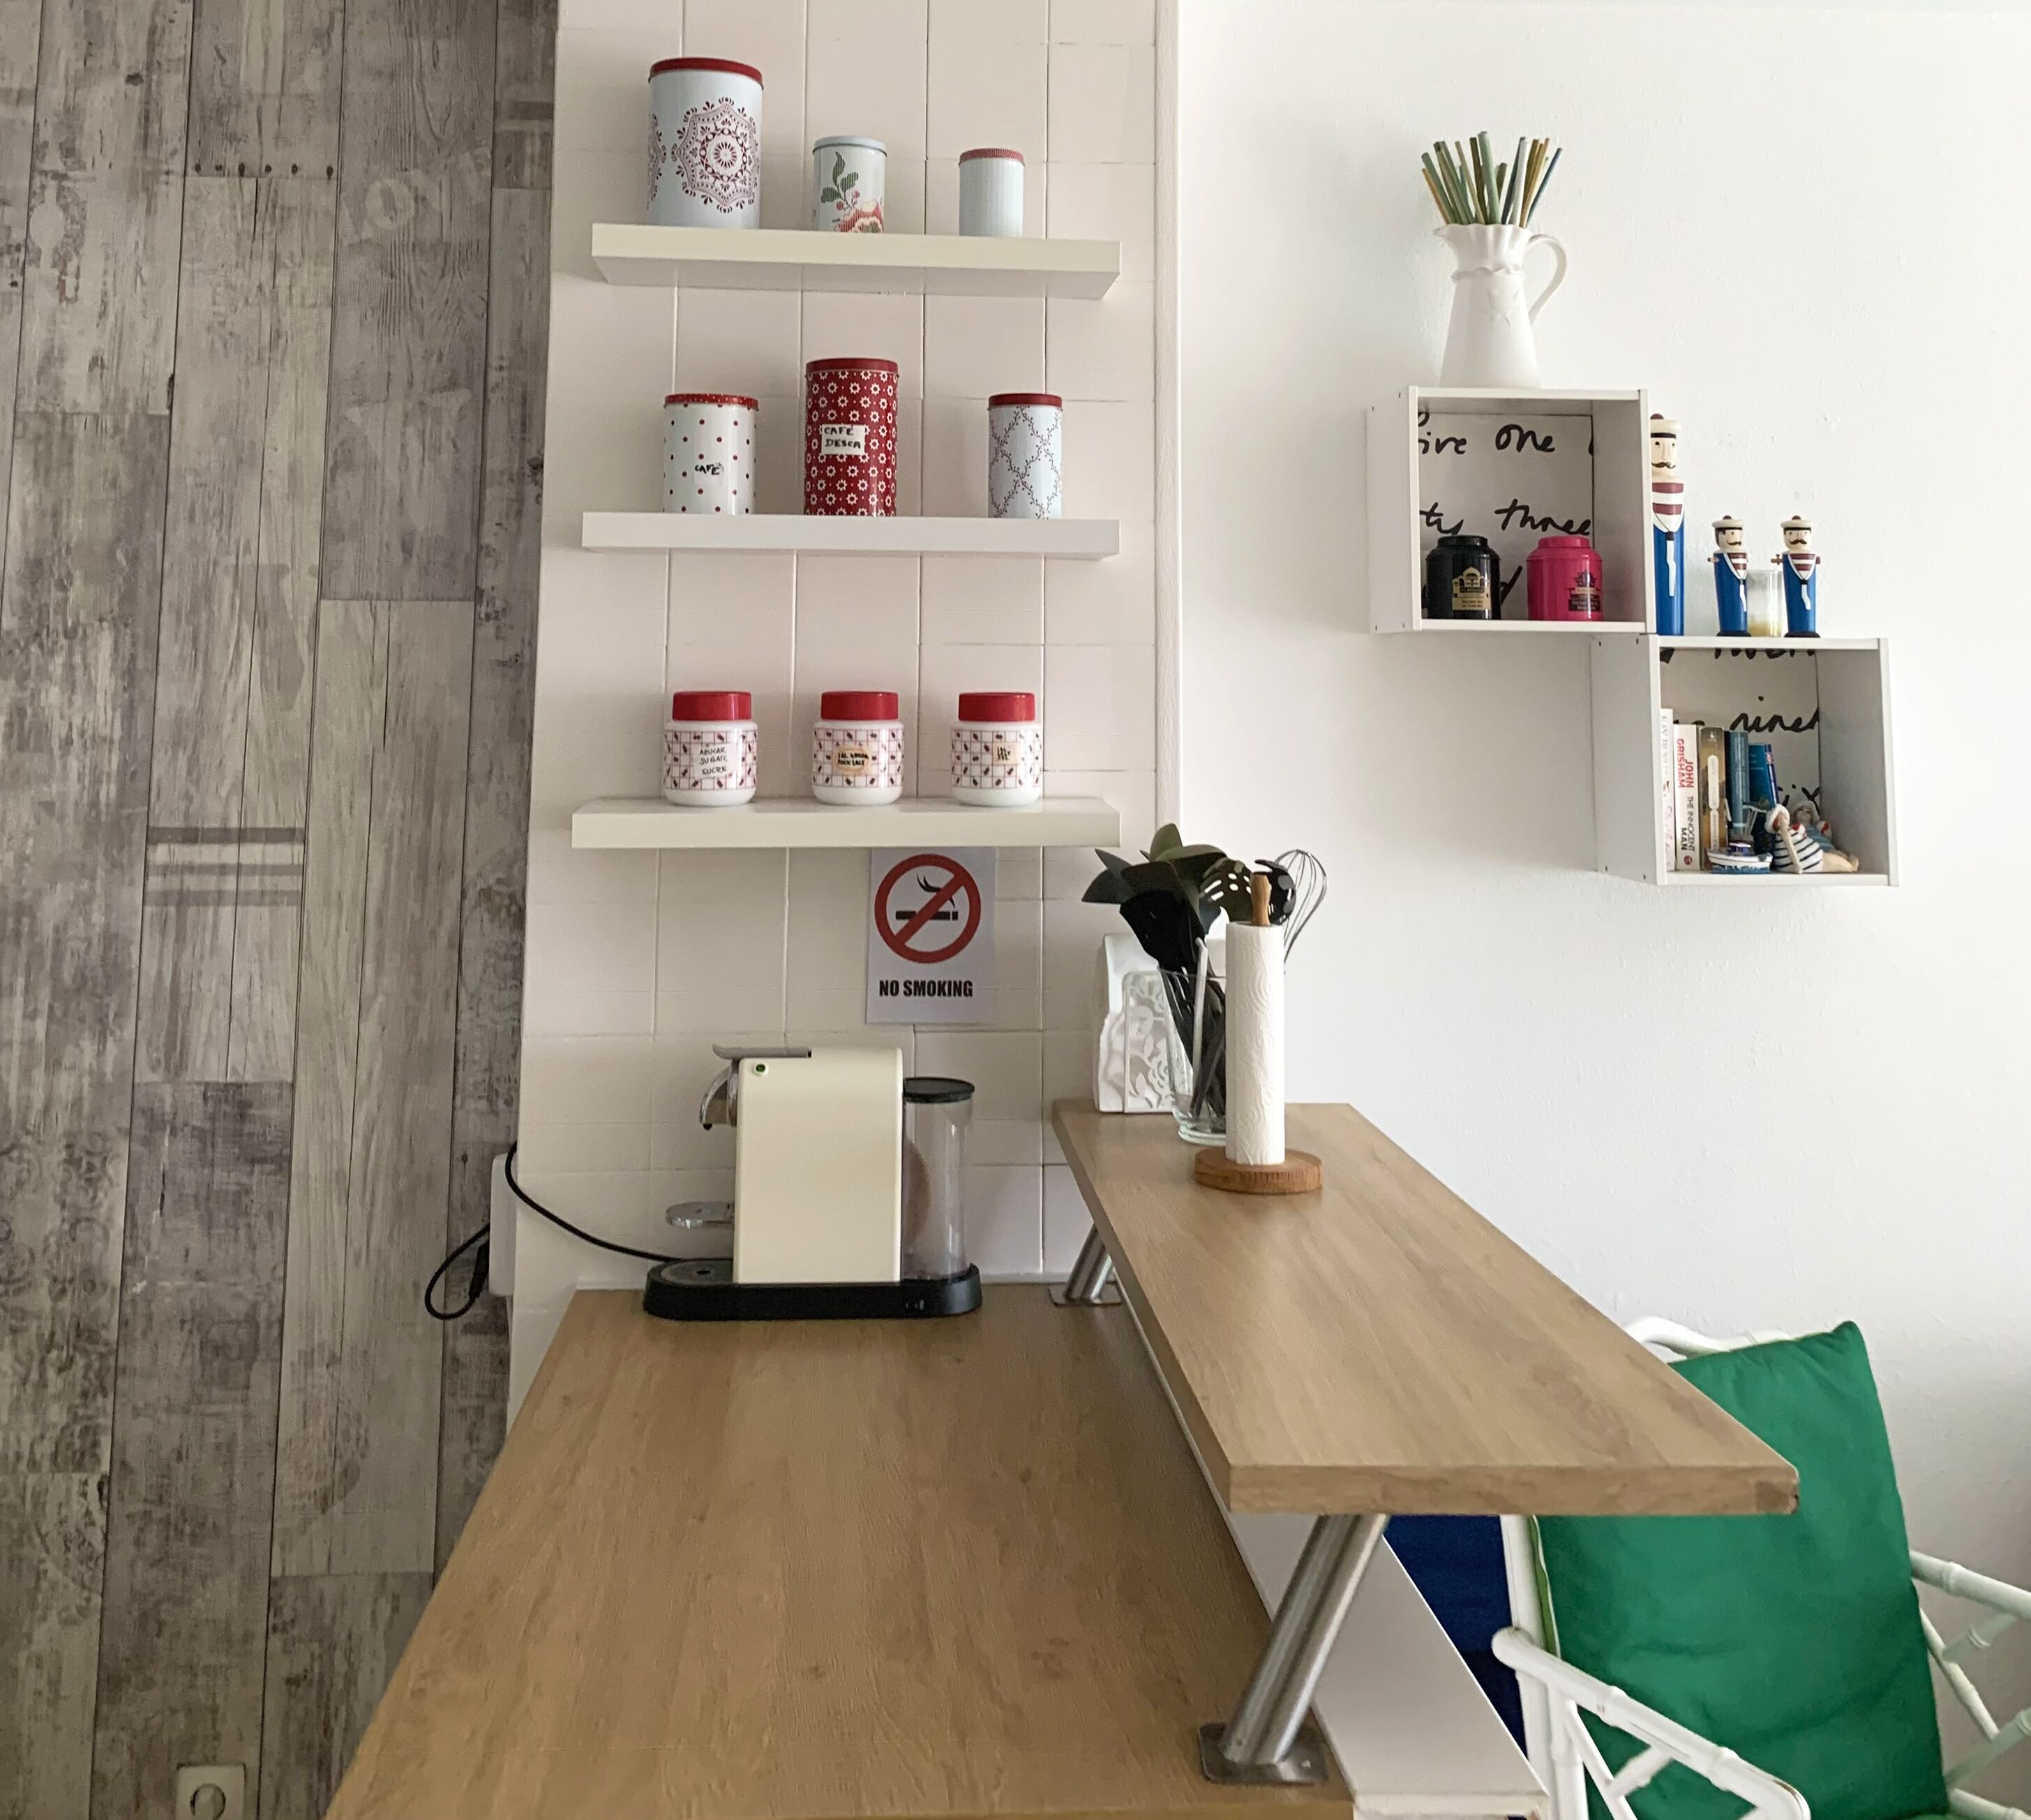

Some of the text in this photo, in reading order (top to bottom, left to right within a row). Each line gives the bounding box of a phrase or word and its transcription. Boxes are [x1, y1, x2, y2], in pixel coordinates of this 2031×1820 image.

[1494, 498, 1591, 535] three
[1676, 738, 1686, 788] GRISHAM
[1685, 759, 1694, 788] JOHN
[1687, 811, 1695, 852] INNOCENT
[879, 979, 973, 998] NO SMOKING
